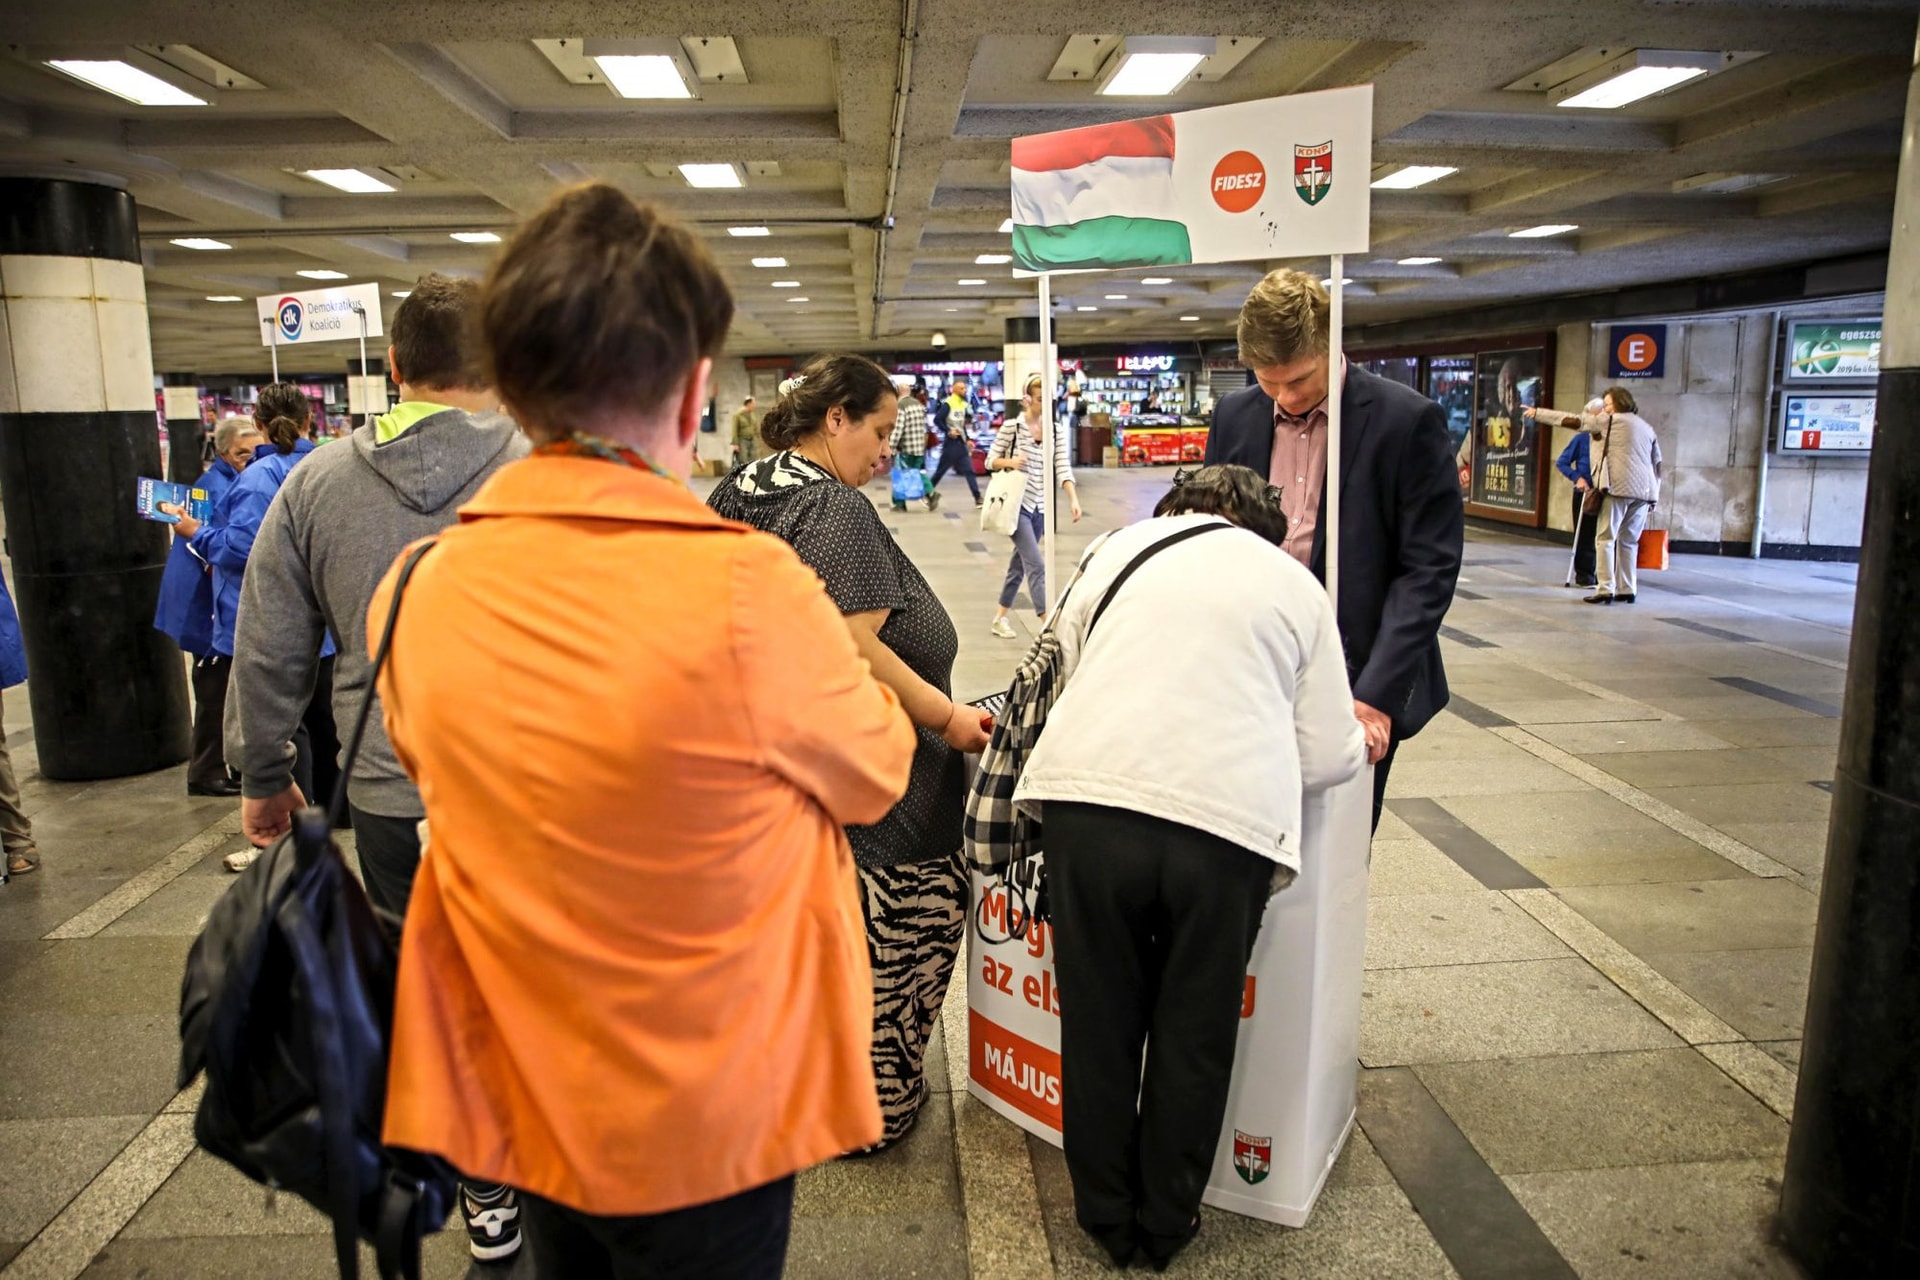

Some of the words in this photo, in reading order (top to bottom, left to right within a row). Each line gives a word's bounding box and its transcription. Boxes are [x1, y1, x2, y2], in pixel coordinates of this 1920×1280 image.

[1297, 145, 1328, 156] KDNP
[1214, 172, 1263, 192] FIDESZ
[307, 298, 362, 315] Demokratikus
[283, 308, 298, 326] dk
[310, 317, 341, 331] Koalíció
[1629, 341, 1645, 363] E
[982, 954, 1014, 997] az
[984, 1041, 1061, 1106] MÁJUS
